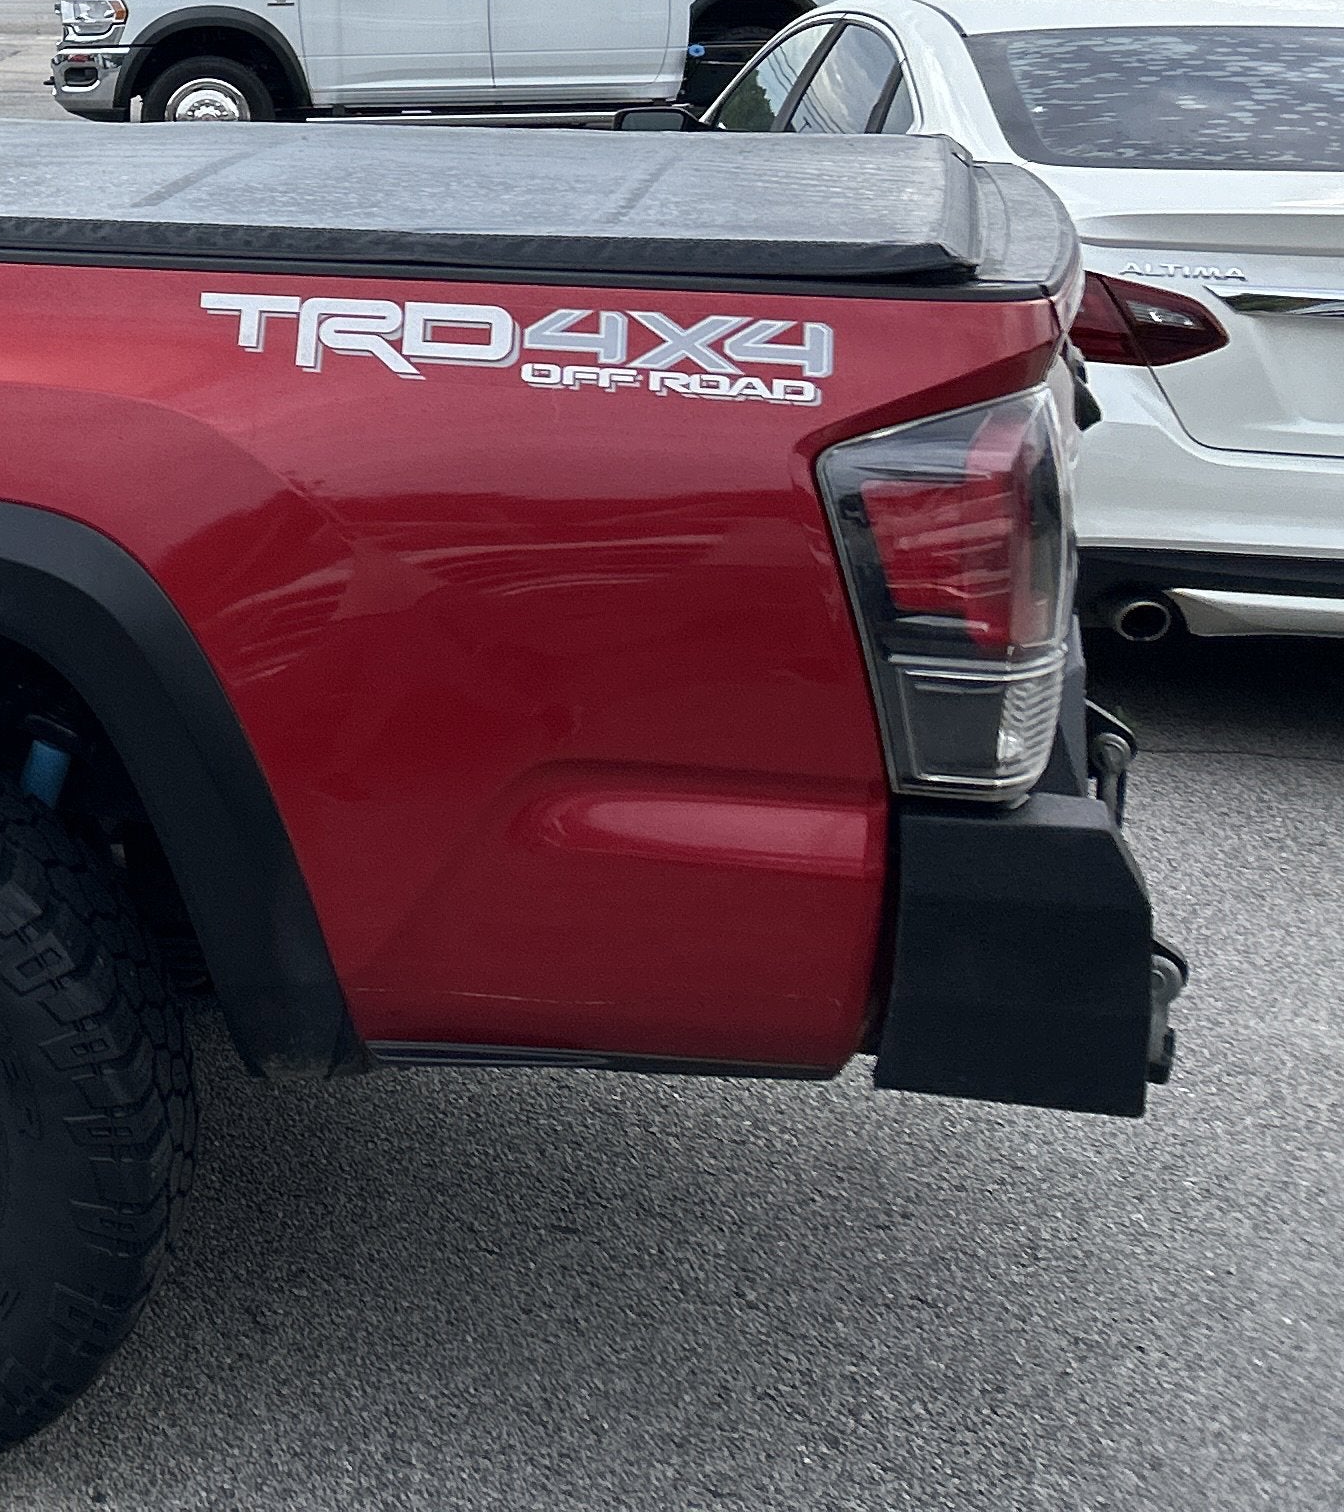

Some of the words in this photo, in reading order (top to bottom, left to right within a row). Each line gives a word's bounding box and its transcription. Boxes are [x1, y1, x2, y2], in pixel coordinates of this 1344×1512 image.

[1118, 262, 1248, 282] ALTIMA
[200, 292, 520, 380] TRD
[520, 362, 642, 391] OFF
[647, 370, 822, 406] ROAD
